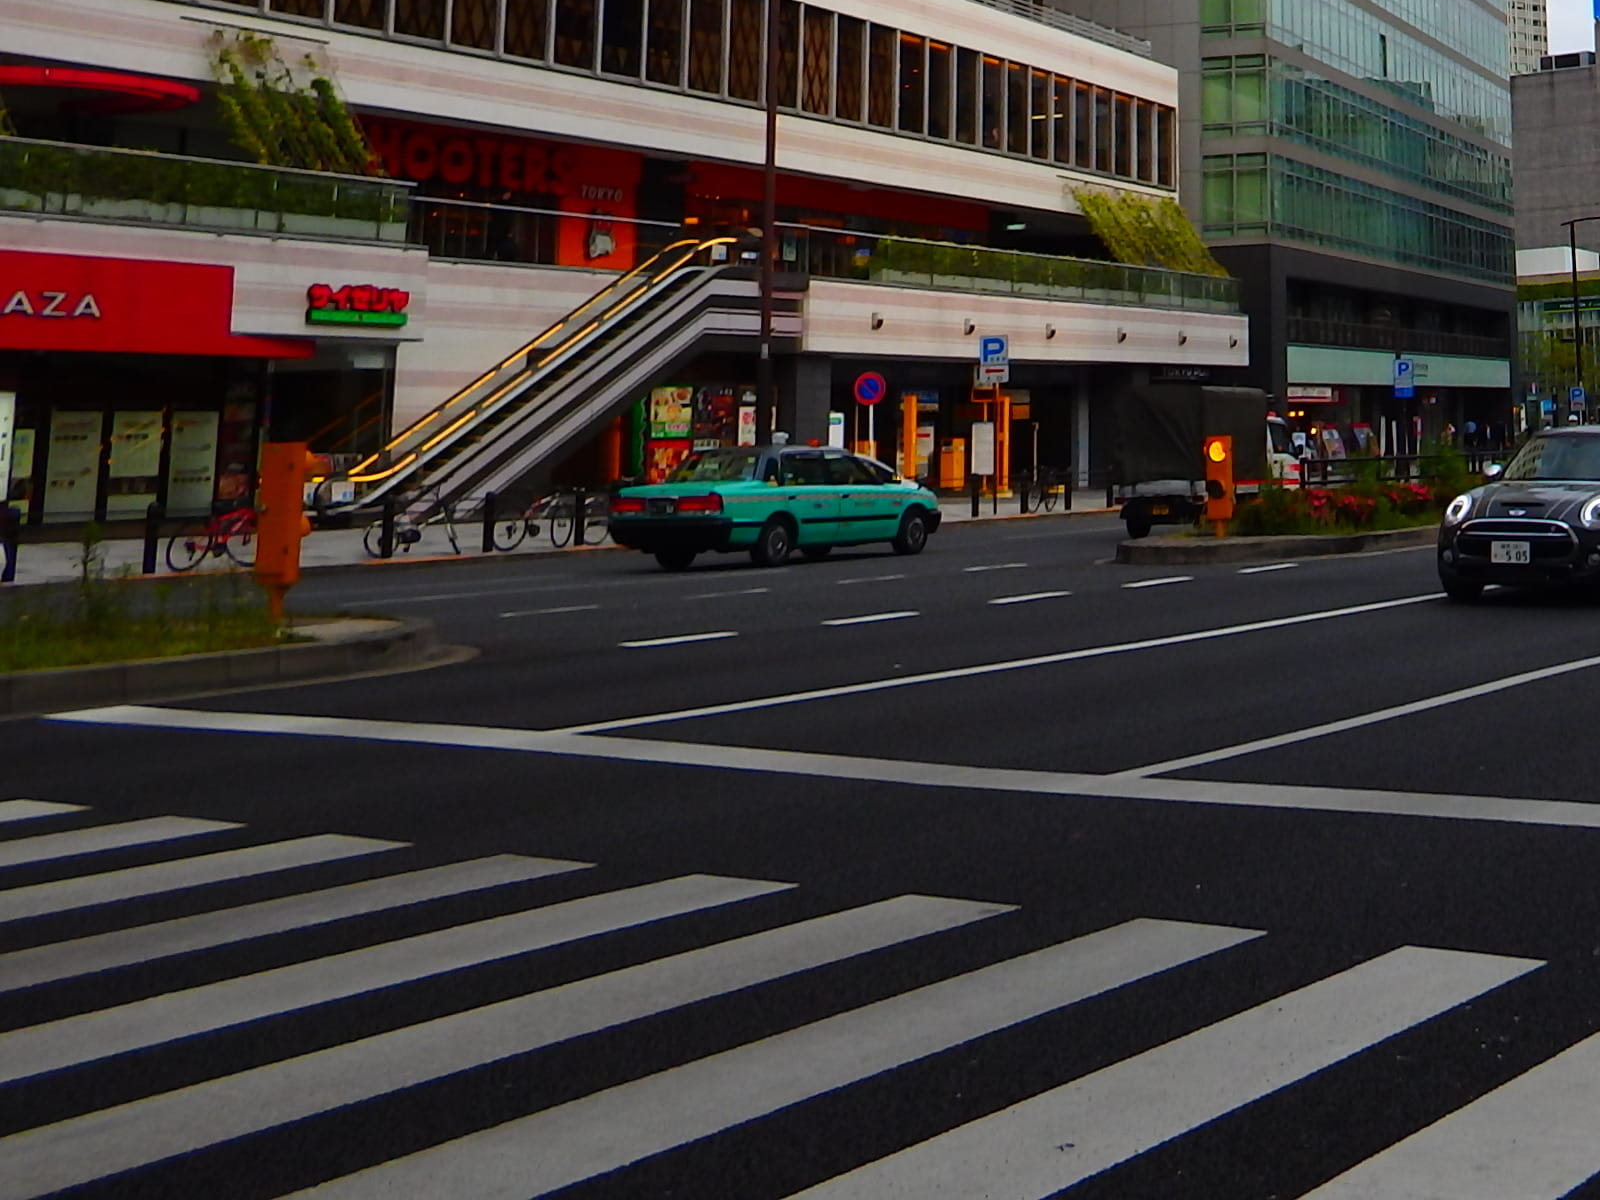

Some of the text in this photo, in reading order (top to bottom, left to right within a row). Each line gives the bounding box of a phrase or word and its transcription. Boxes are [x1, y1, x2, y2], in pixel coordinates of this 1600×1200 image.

[365, 118, 573, 197] HOOTERS
[580, 184, 623, 202] TOKYO
[3, 290, 101, 318] AZA
[307, 283, 410, 313] サイゼリヤ
[983, 338, 1005, 362] P
[1398, 362, 1409, 376] P
[1571, 389, 1583, 403] P
